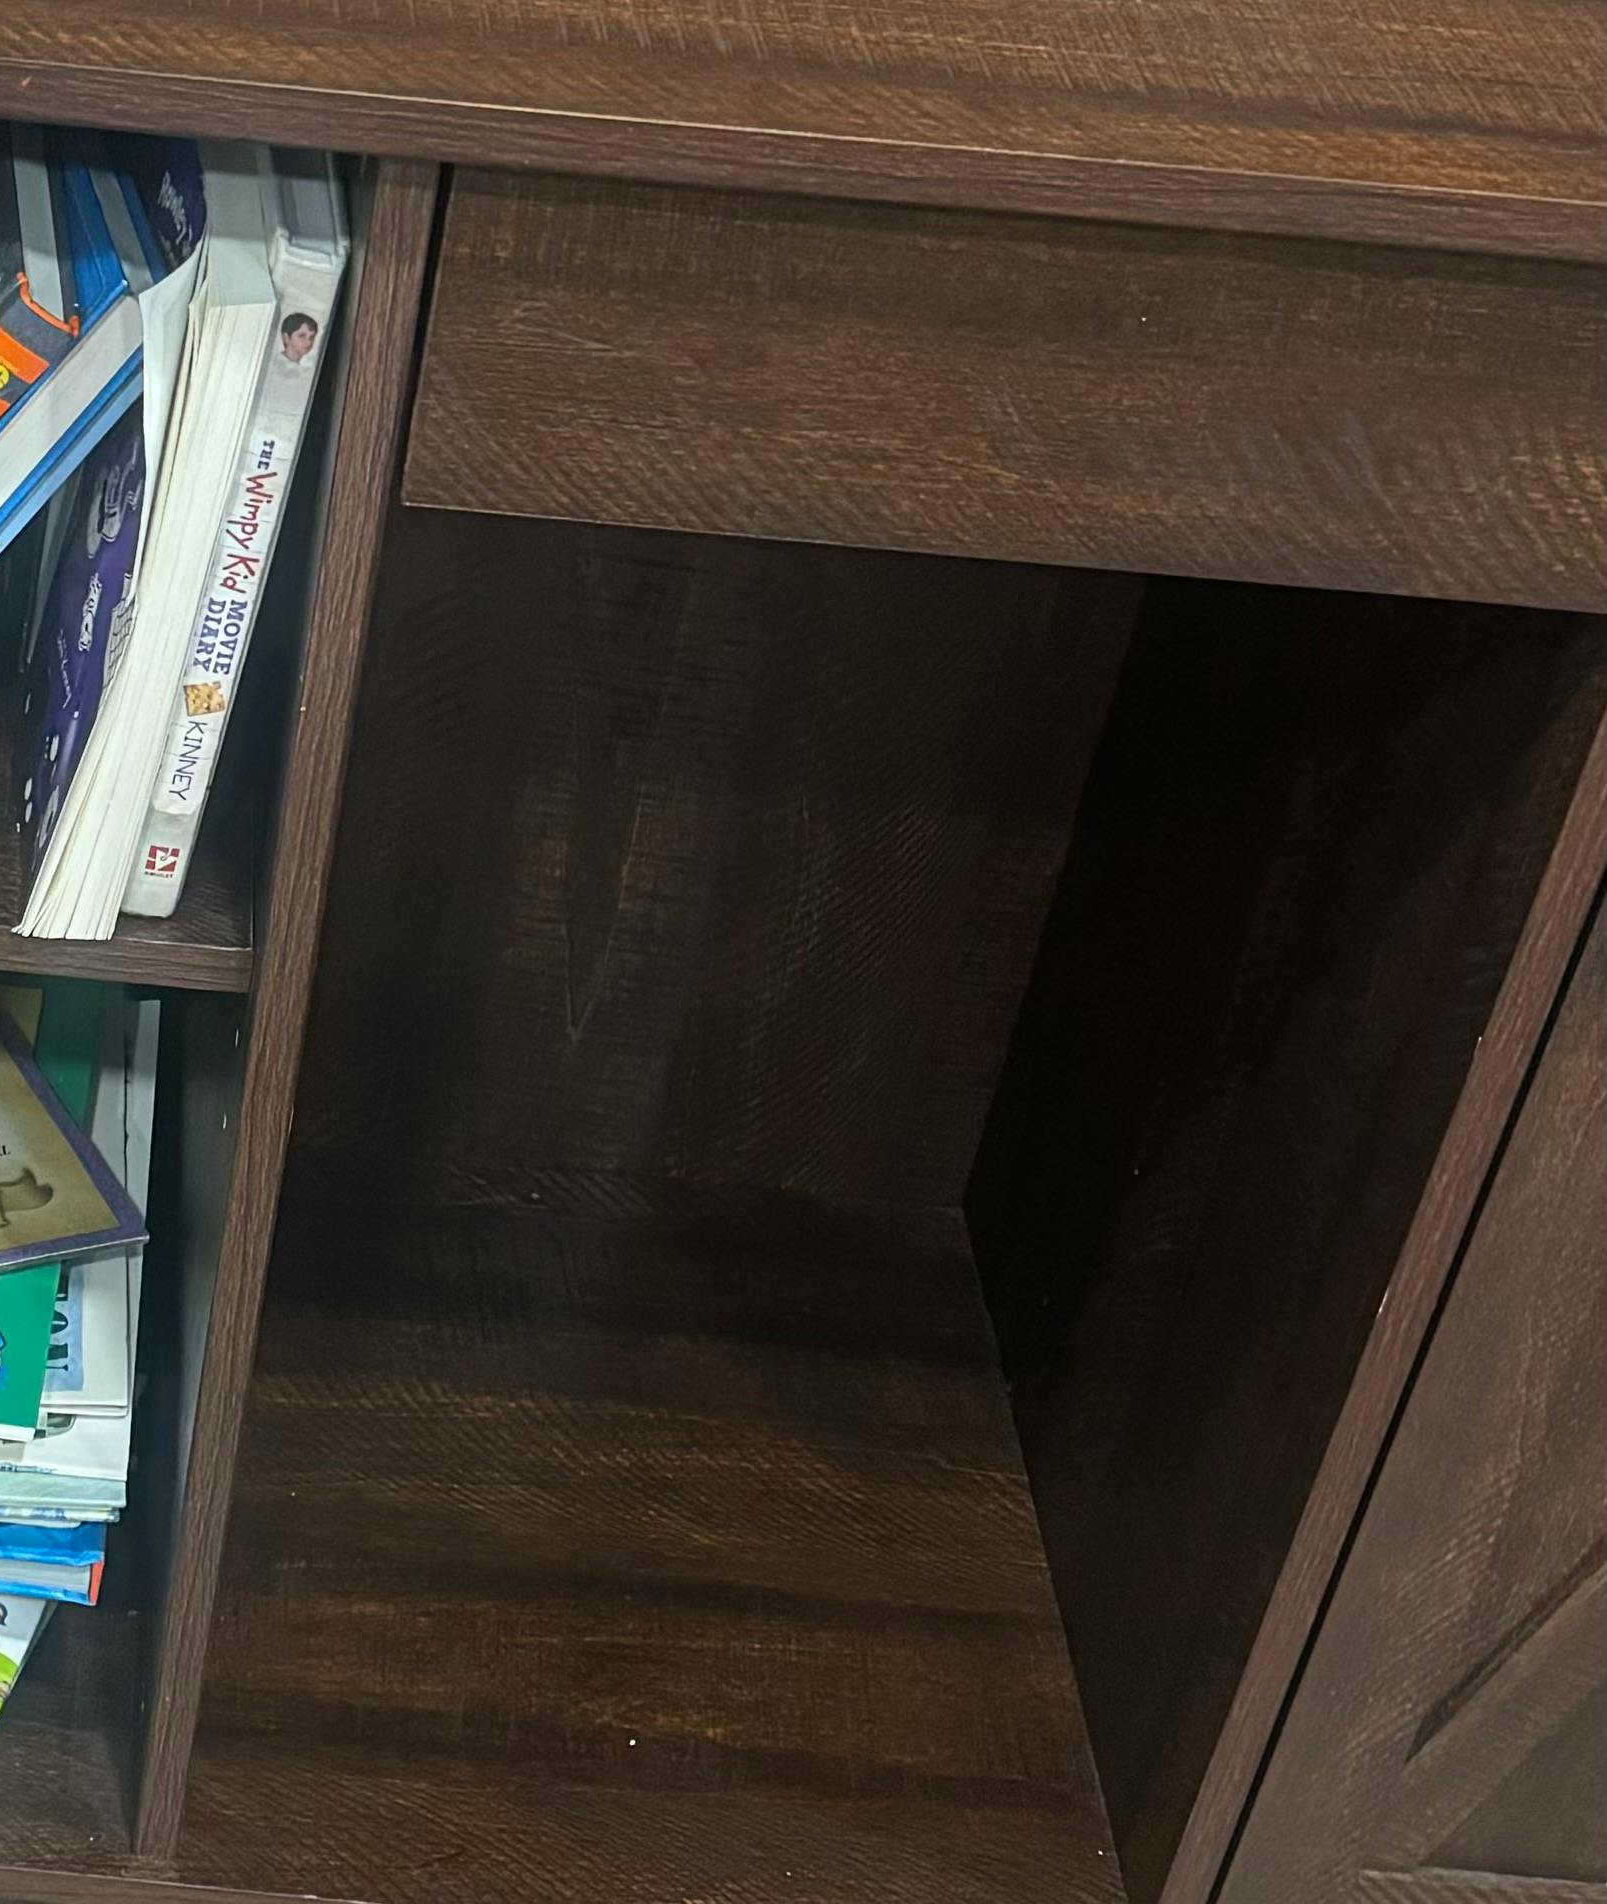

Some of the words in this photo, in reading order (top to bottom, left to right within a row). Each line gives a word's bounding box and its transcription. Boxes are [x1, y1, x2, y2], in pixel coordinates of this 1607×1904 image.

[257, 440, 275, 470] THE
[226, 472, 277, 549] Wimpy
[220, 554, 260, 594] Kid
[194, 597, 226, 672] DIARY
[213, 600, 248, 675] MOVIE
[168, 721, 208, 800] KINNEY
